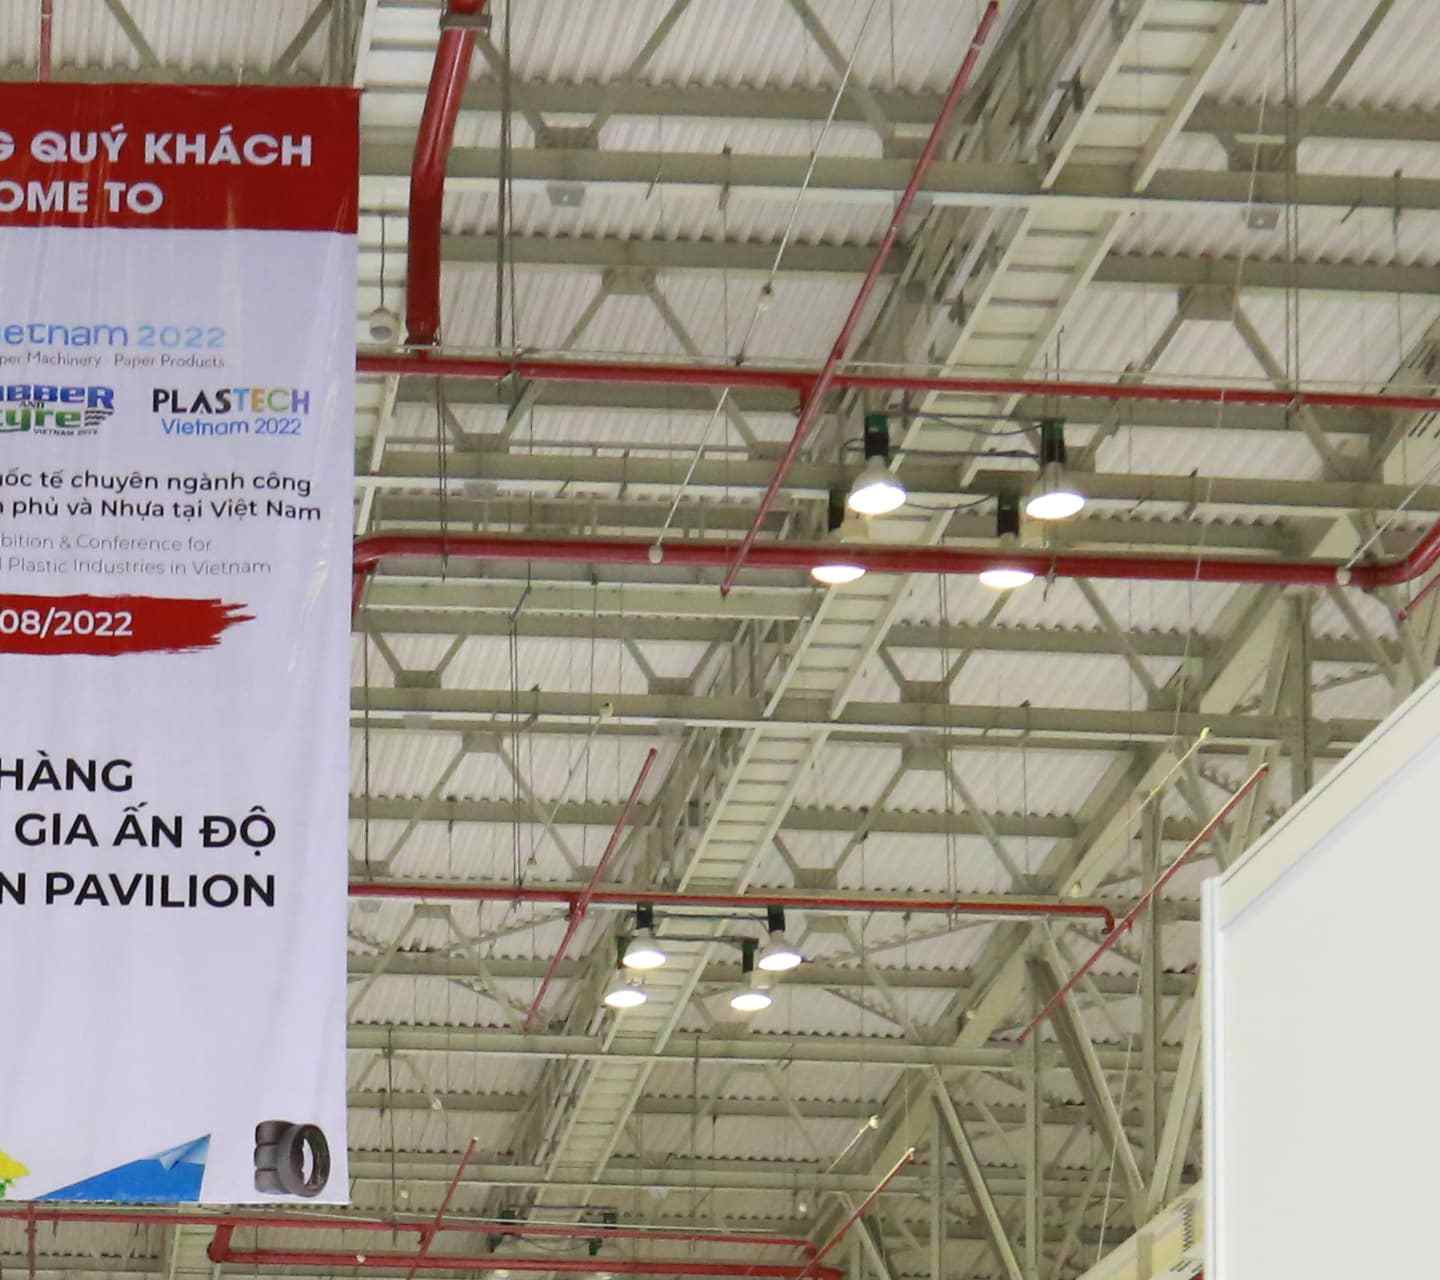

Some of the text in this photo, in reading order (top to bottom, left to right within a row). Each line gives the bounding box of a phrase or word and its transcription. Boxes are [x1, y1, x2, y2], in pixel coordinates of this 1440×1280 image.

[30, 124, 125, 166] QUÝ
[144, 126, 312, 167] KHÁCH
[105, 182, 162, 214] TO
[138, 324, 225, 348] 2022
[152, 388, 310, 414] PLASTECH
[161, 417, 302, 436] Vietnam 2022
[41, 468, 63, 489] tế
[71, 471, 158, 493] chuyên
[168, 472, 244, 493] ngành
[253, 475, 311, 497] công
[13, 497, 57, 518] phủ
[68, 499, 92, 515] và
[102, 499, 164, 521] Nhựa
[211, 500, 257, 520] Việt
[267, 502, 320, 520] Nam
[77, 535, 182, 551] Conference
[189, 536, 211, 551] for
[9, 557, 68, 573] Plastic
[74, 559, 164, 575] Industries
[171, 560, 186, 575] in
[193, 560, 271, 576] Vietnam
[15, 811, 99, 846] GIA
[112, 800, 182, 849] ẤN
[199, 805, 276, 856] ĐỘ
[45, 872, 276, 908] PAVILION
